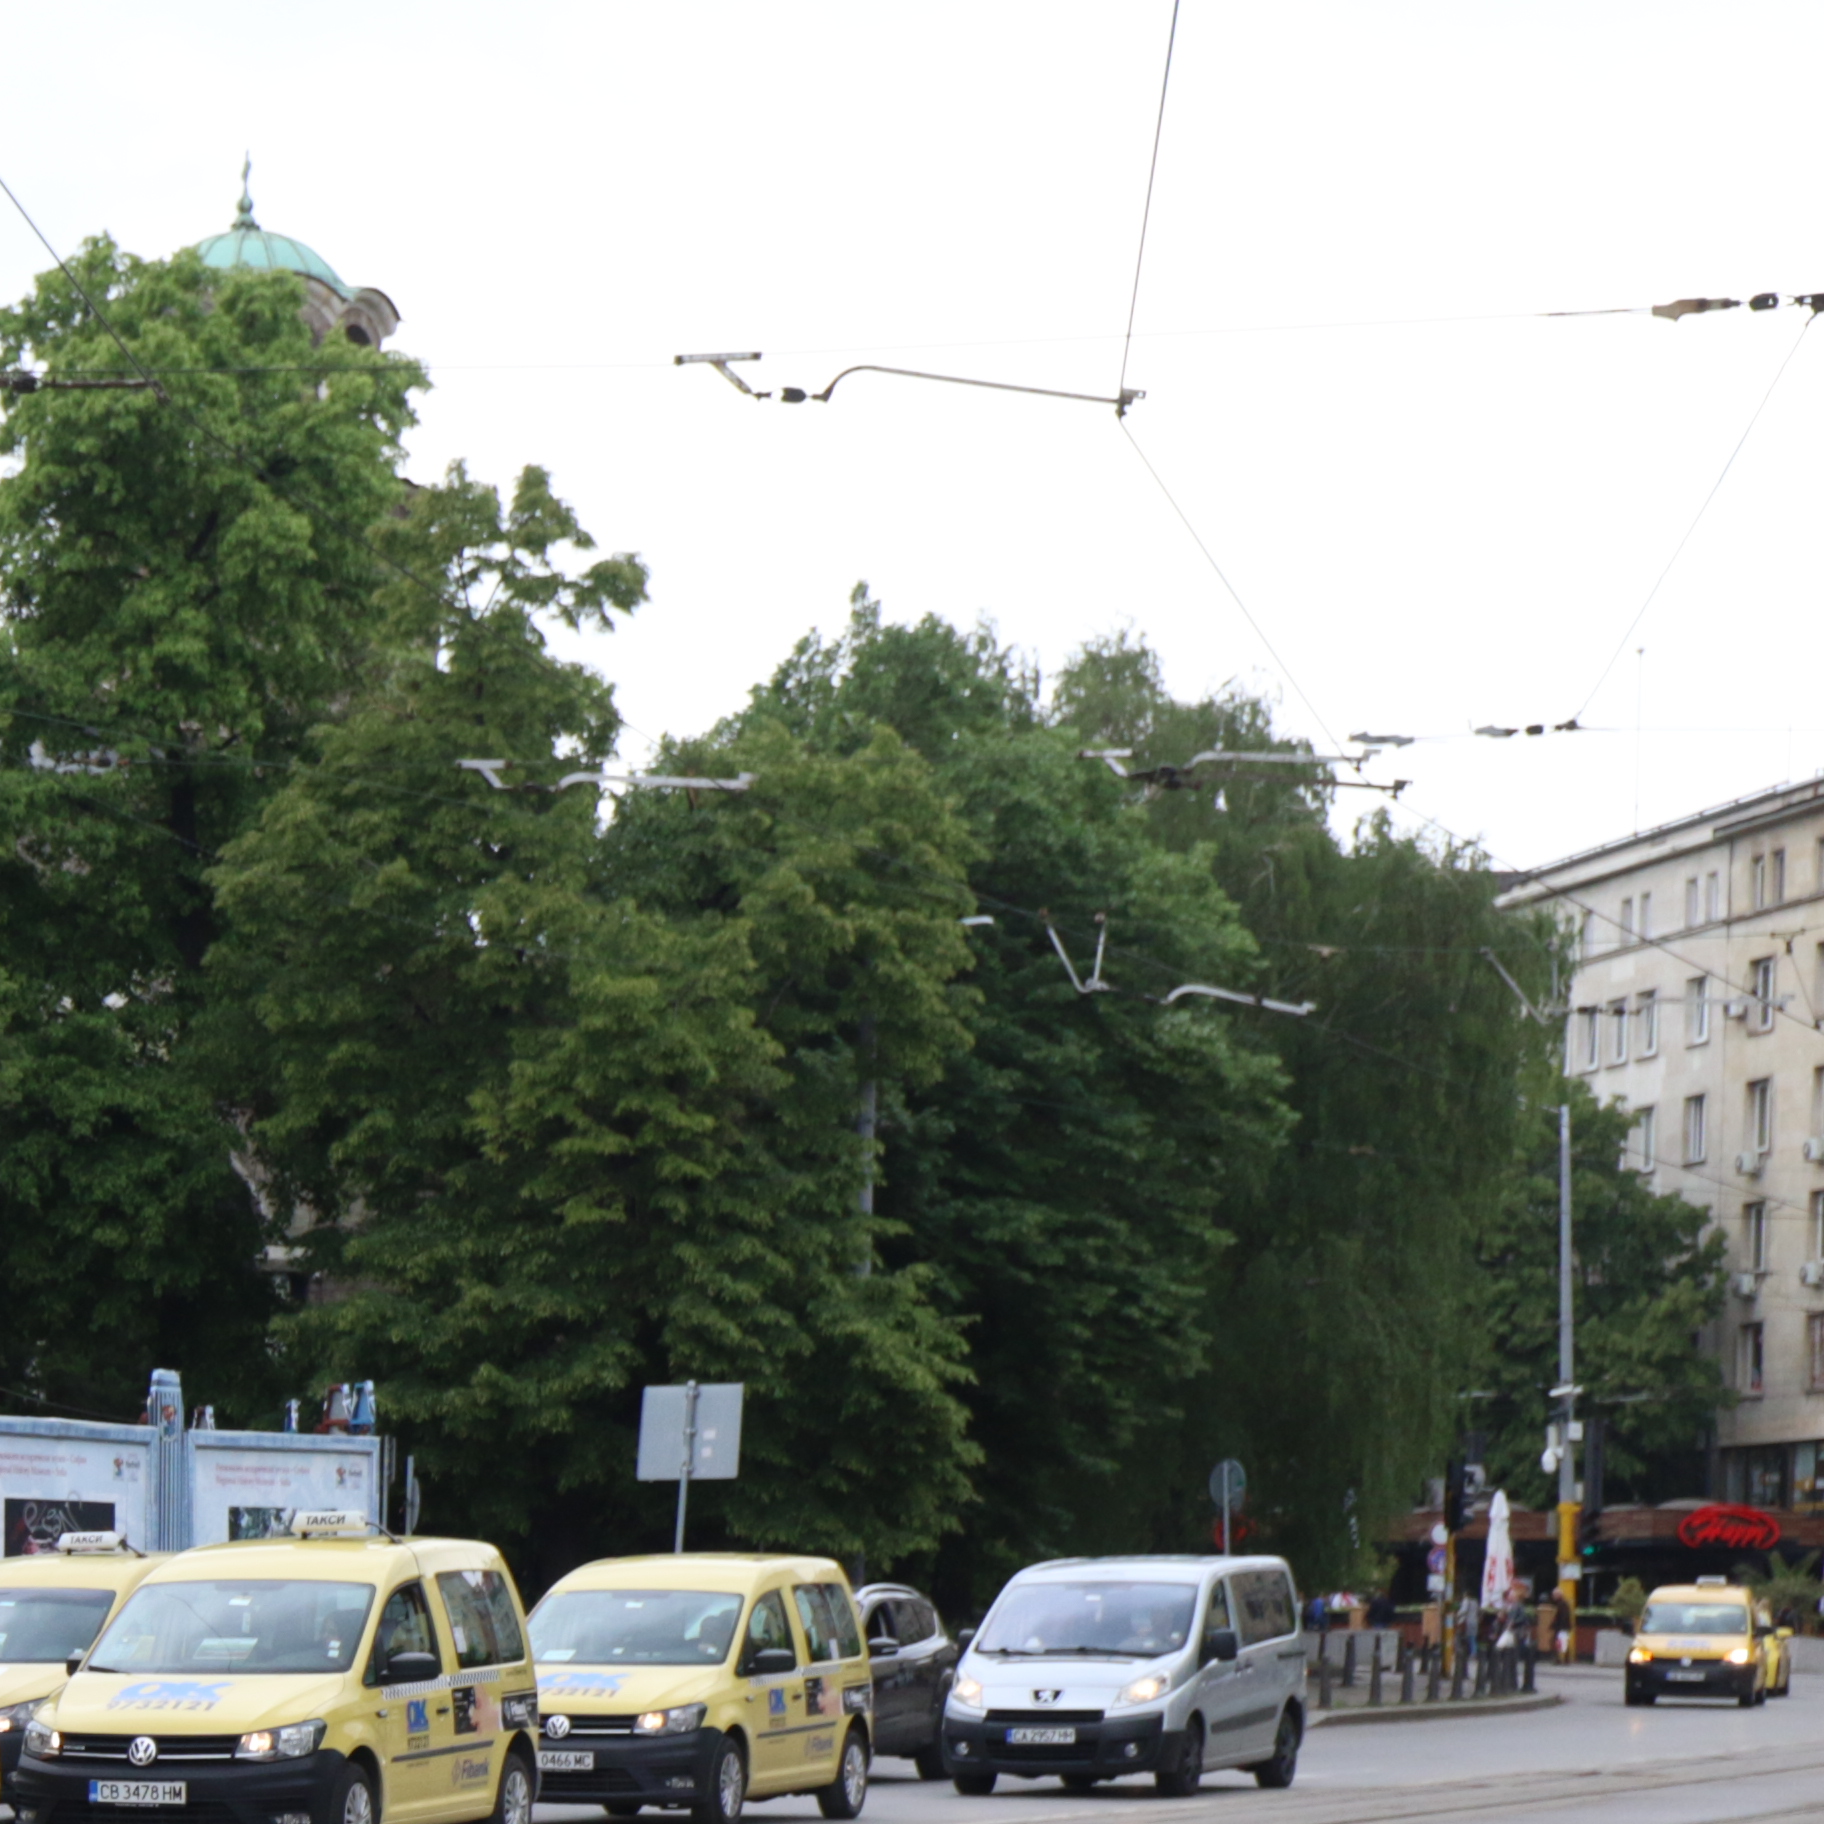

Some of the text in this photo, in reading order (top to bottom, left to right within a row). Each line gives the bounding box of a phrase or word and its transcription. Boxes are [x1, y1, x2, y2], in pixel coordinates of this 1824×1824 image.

[306, 1515, 346, 1526] ТАКСИ
[71, 1535, 103, 1544] ТАКСИ
[542, 1754, 571, 1767] 0466
[123, 1785, 159, 1800] 3478
